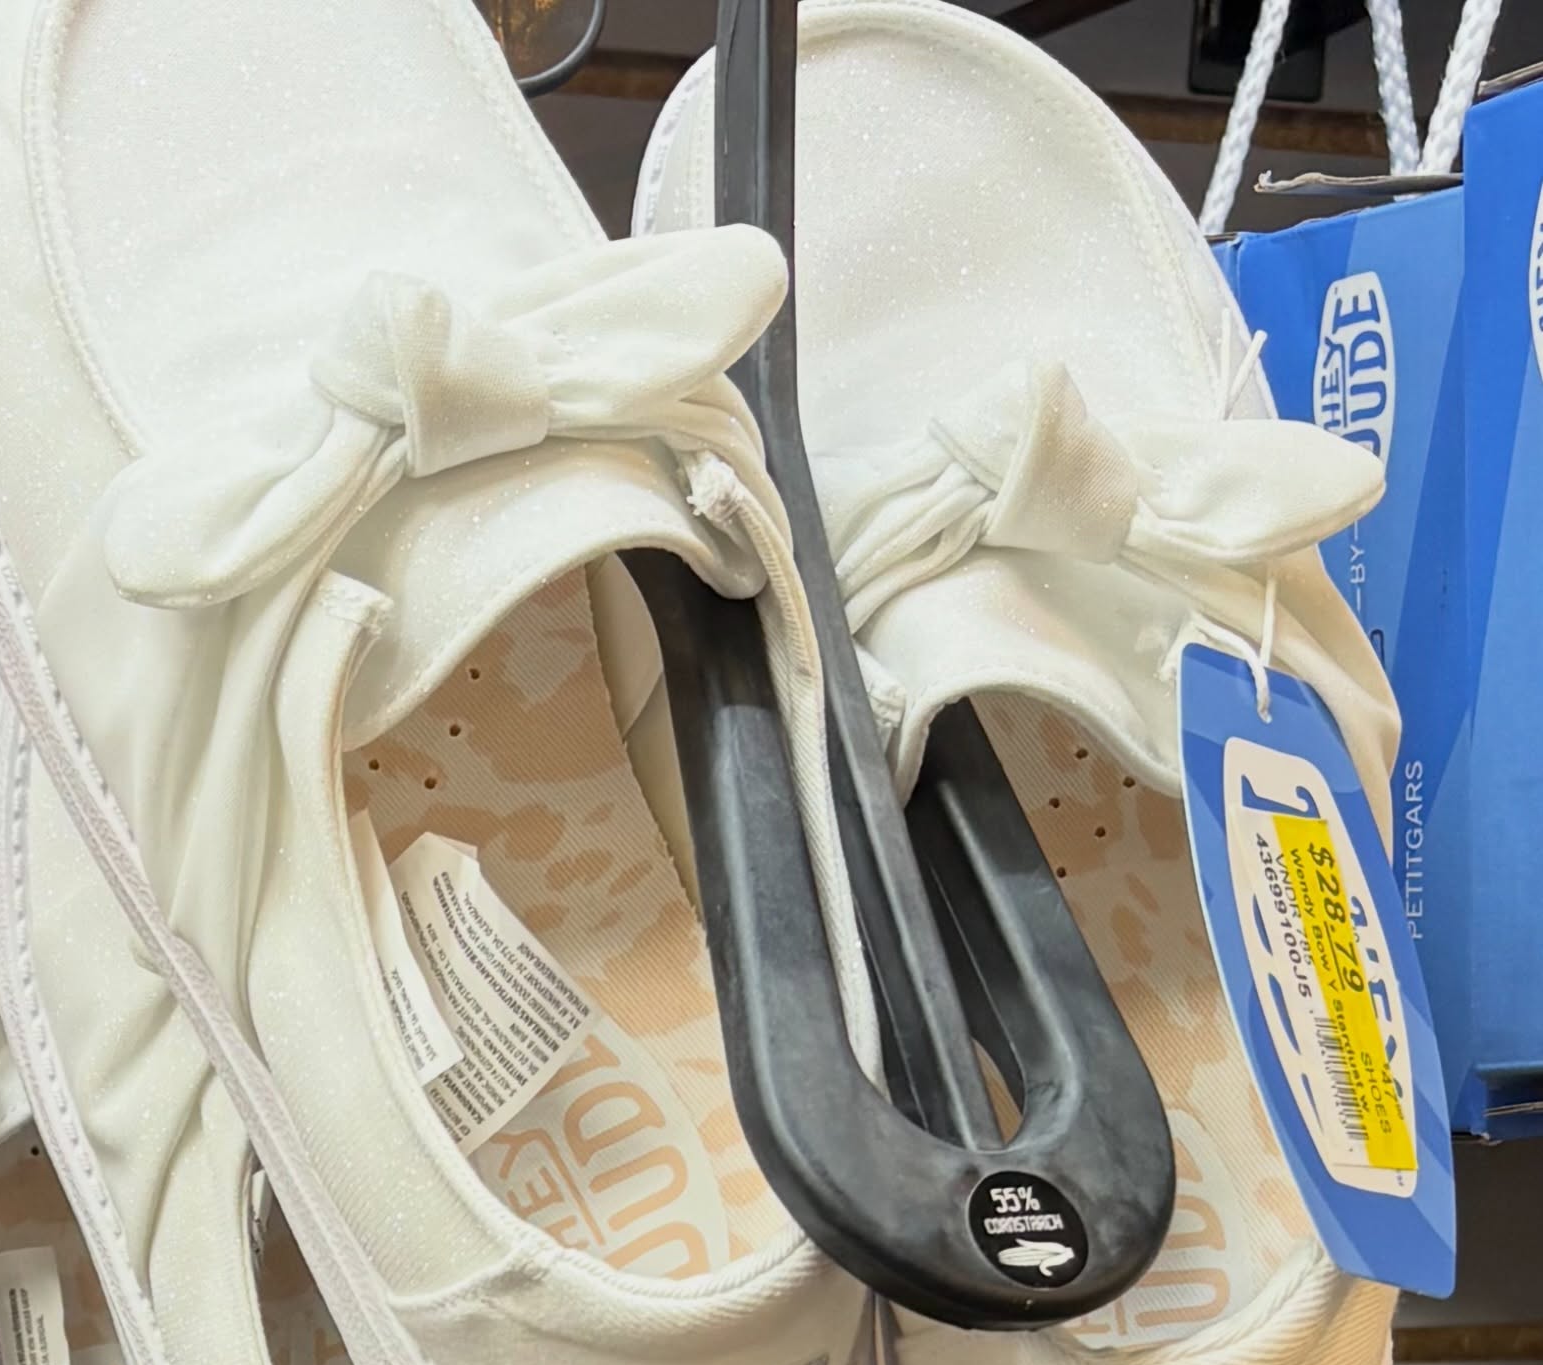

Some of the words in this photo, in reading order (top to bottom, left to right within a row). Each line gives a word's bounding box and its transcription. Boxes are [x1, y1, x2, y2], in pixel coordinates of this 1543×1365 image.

[1350, 545, 1366, 584] BY
[1273, 853, 1302, 920] VNDR
[1405, 758, 1425, 941] PETITGARS
[1287, 847, 1318, 920] Wendy
[1309, 923, 1334, 976] Bow
[1304, 839, 1368, 996] $28.79
[1357, 1050, 1394, 1135] SHOES
[990, 1186, 1041, 1214] 55%
